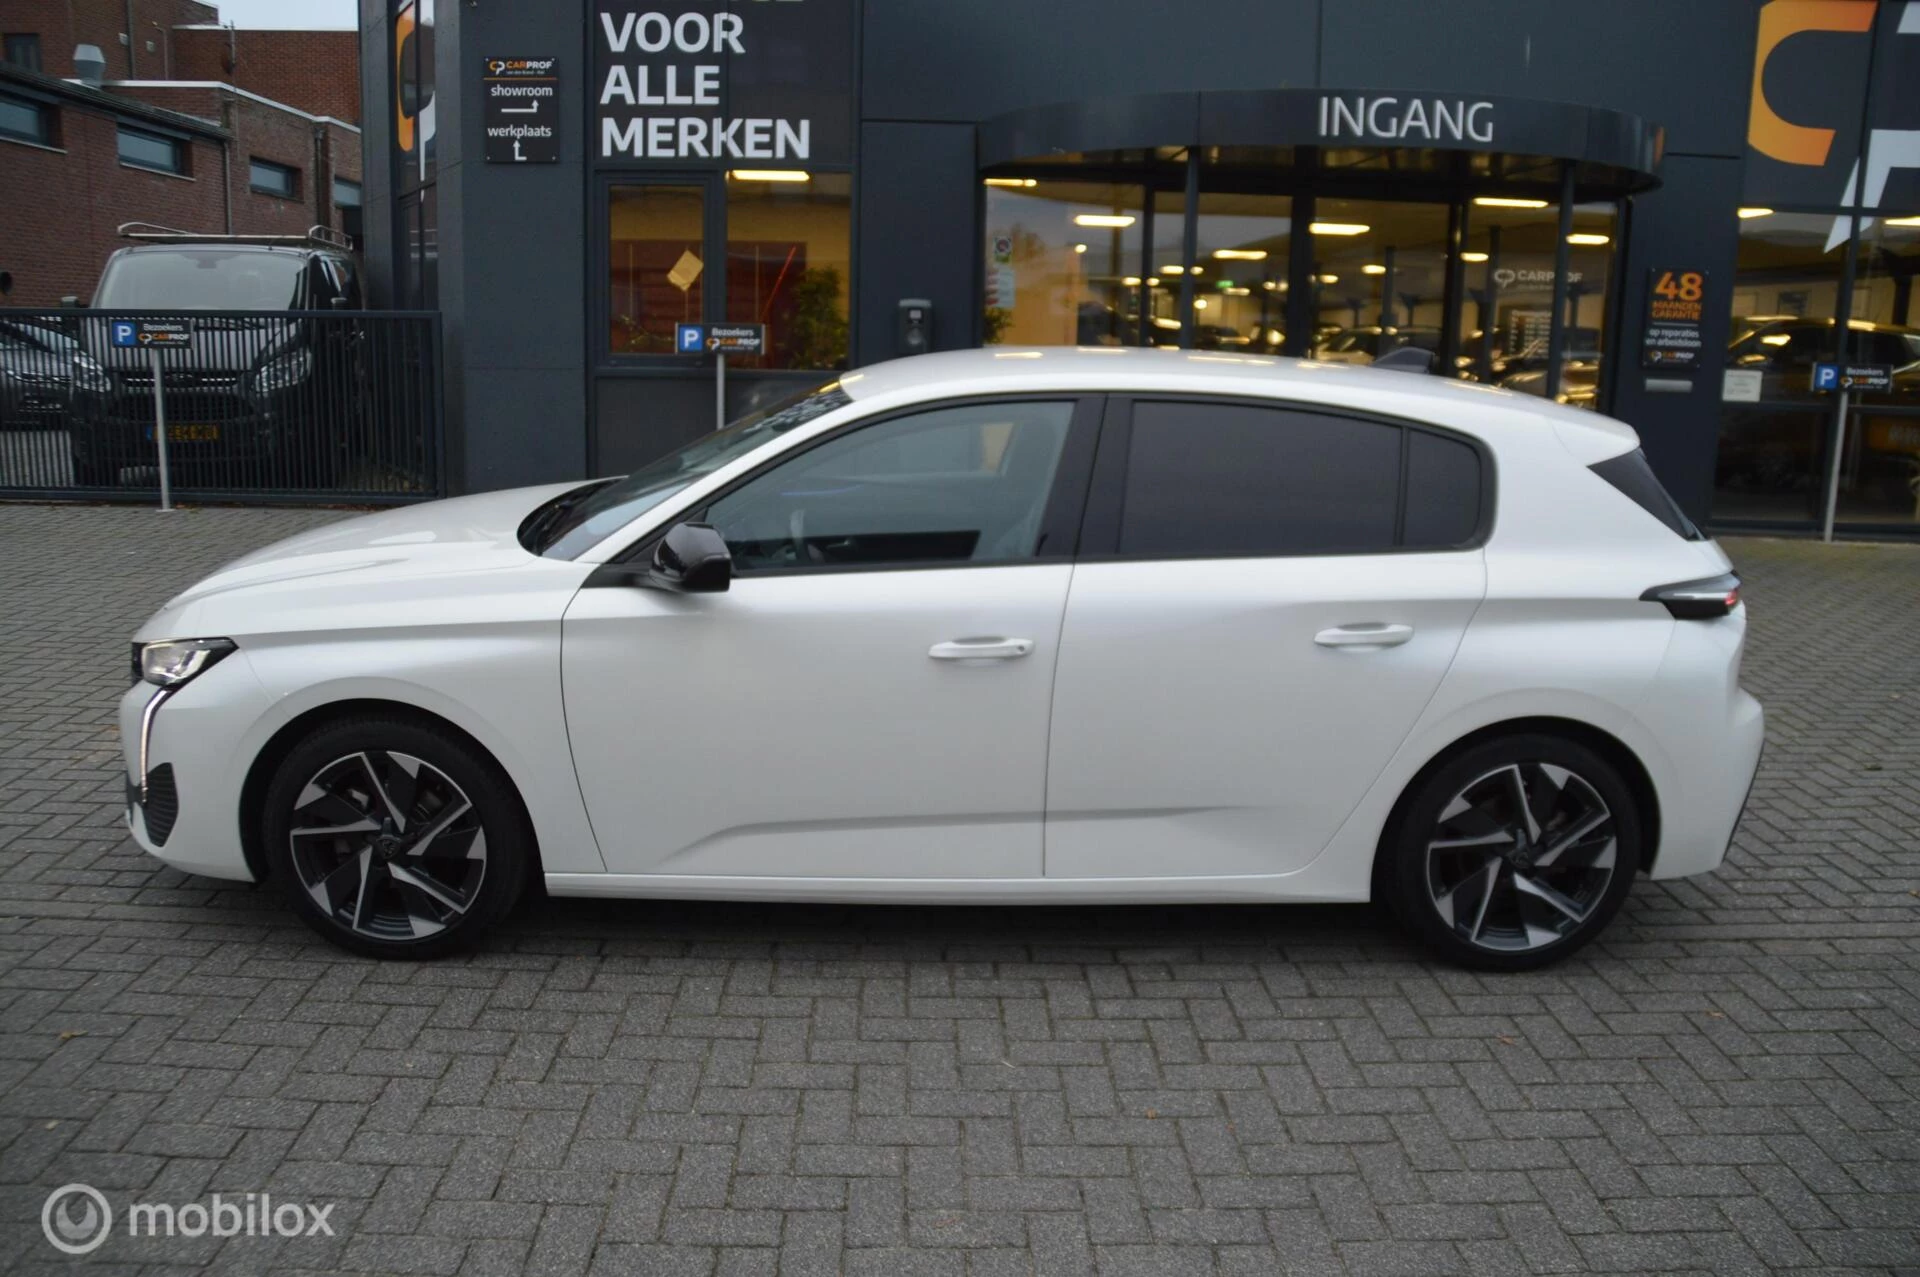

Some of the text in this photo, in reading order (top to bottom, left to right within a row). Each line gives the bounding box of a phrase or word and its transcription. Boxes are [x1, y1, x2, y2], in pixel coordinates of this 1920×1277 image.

[600, 12, 746, 53] VOOR
[506, 61, 552, 69] CARPROF
[490, 84, 553, 96] showroom
[600, 65, 720, 105] ALLE
[1319, 96, 1494, 142] INGANG
[487, 124, 552, 139] werkplaats
[602, 117, 810, 159] MERKEN
[1655, 271, 1703, 301] 48
[1651, 310, 1700, 320] GARANTIE
[143, 323, 184, 332] Bezoekers
[711, 327, 754, 336] Bezoekers
[1661, 329, 1699, 338] reparaties
